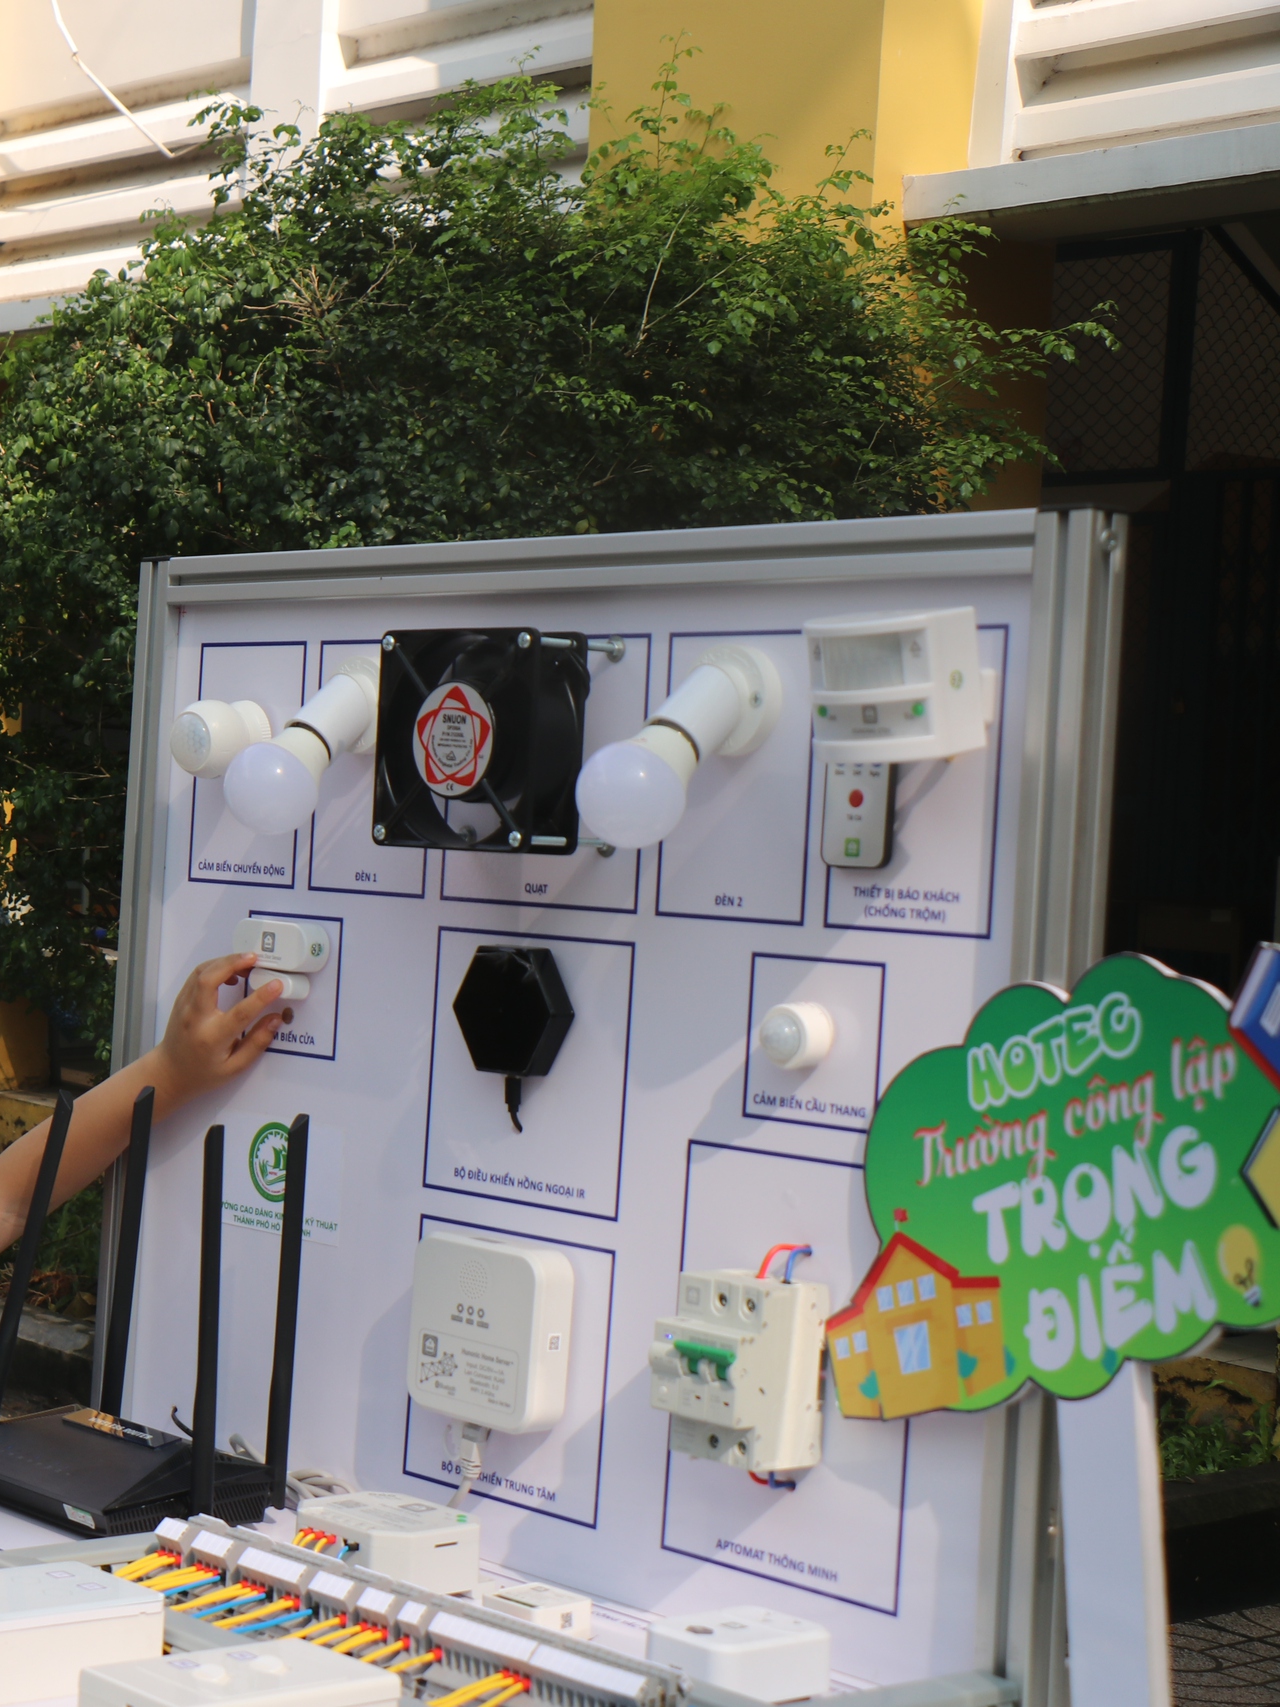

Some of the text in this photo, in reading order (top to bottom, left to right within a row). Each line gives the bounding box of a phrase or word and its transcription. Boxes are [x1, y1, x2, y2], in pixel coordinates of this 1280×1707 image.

[198, 859, 214, 871] CẢM
[263, 864, 285, 876] ĐỘNG
[355, 869, 377, 882] ĐÈN 1
[524, 883, 548, 895] QUẠT
[715, 895, 743, 907] ĐÈN 2
[853, 884, 959, 903] THIẾT BỊ BÁO KHÁCH
[864, 904, 946, 923] (CHỐNG TRỘM)
[280, 1030, 297, 1043] BIẾN
[299, 1032, 315, 1045] CỬA
[967, 991, 1142, 1111] HOTEC
[753, 1090, 866, 1118] CẢM BIẾN CẦU THANG
[913, 1035, 1237, 1187] Trường công lập
[454, 1166, 466, 1179] BỘ
[468, 1167, 488, 1182] ĐIỀU
[517, 1176, 543, 1192] HỒNG
[545, 1182, 574, 1199] NGOẠI
[576, 1188, 586, 1199] IR
[972, 1124, 1216, 1264] TRỌNG
[233, 1214, 255, 1226] THÀNH
[256, 1218, 269, 1229] PHỐ
[240, 1204, 253, 1215] CAO
[316, 1219, 338, 1232] THUẬT
[1024, 1226, 1217, 1371] ĐIỂM
[441, 1460, 453, 1473] BỘ
[504, 1478, 534, 1496] TRUNG
[536, 1486, 556, 1501] TÂM
[716, 1538, 838, 1582] APTOMAT THÔNG MINH
